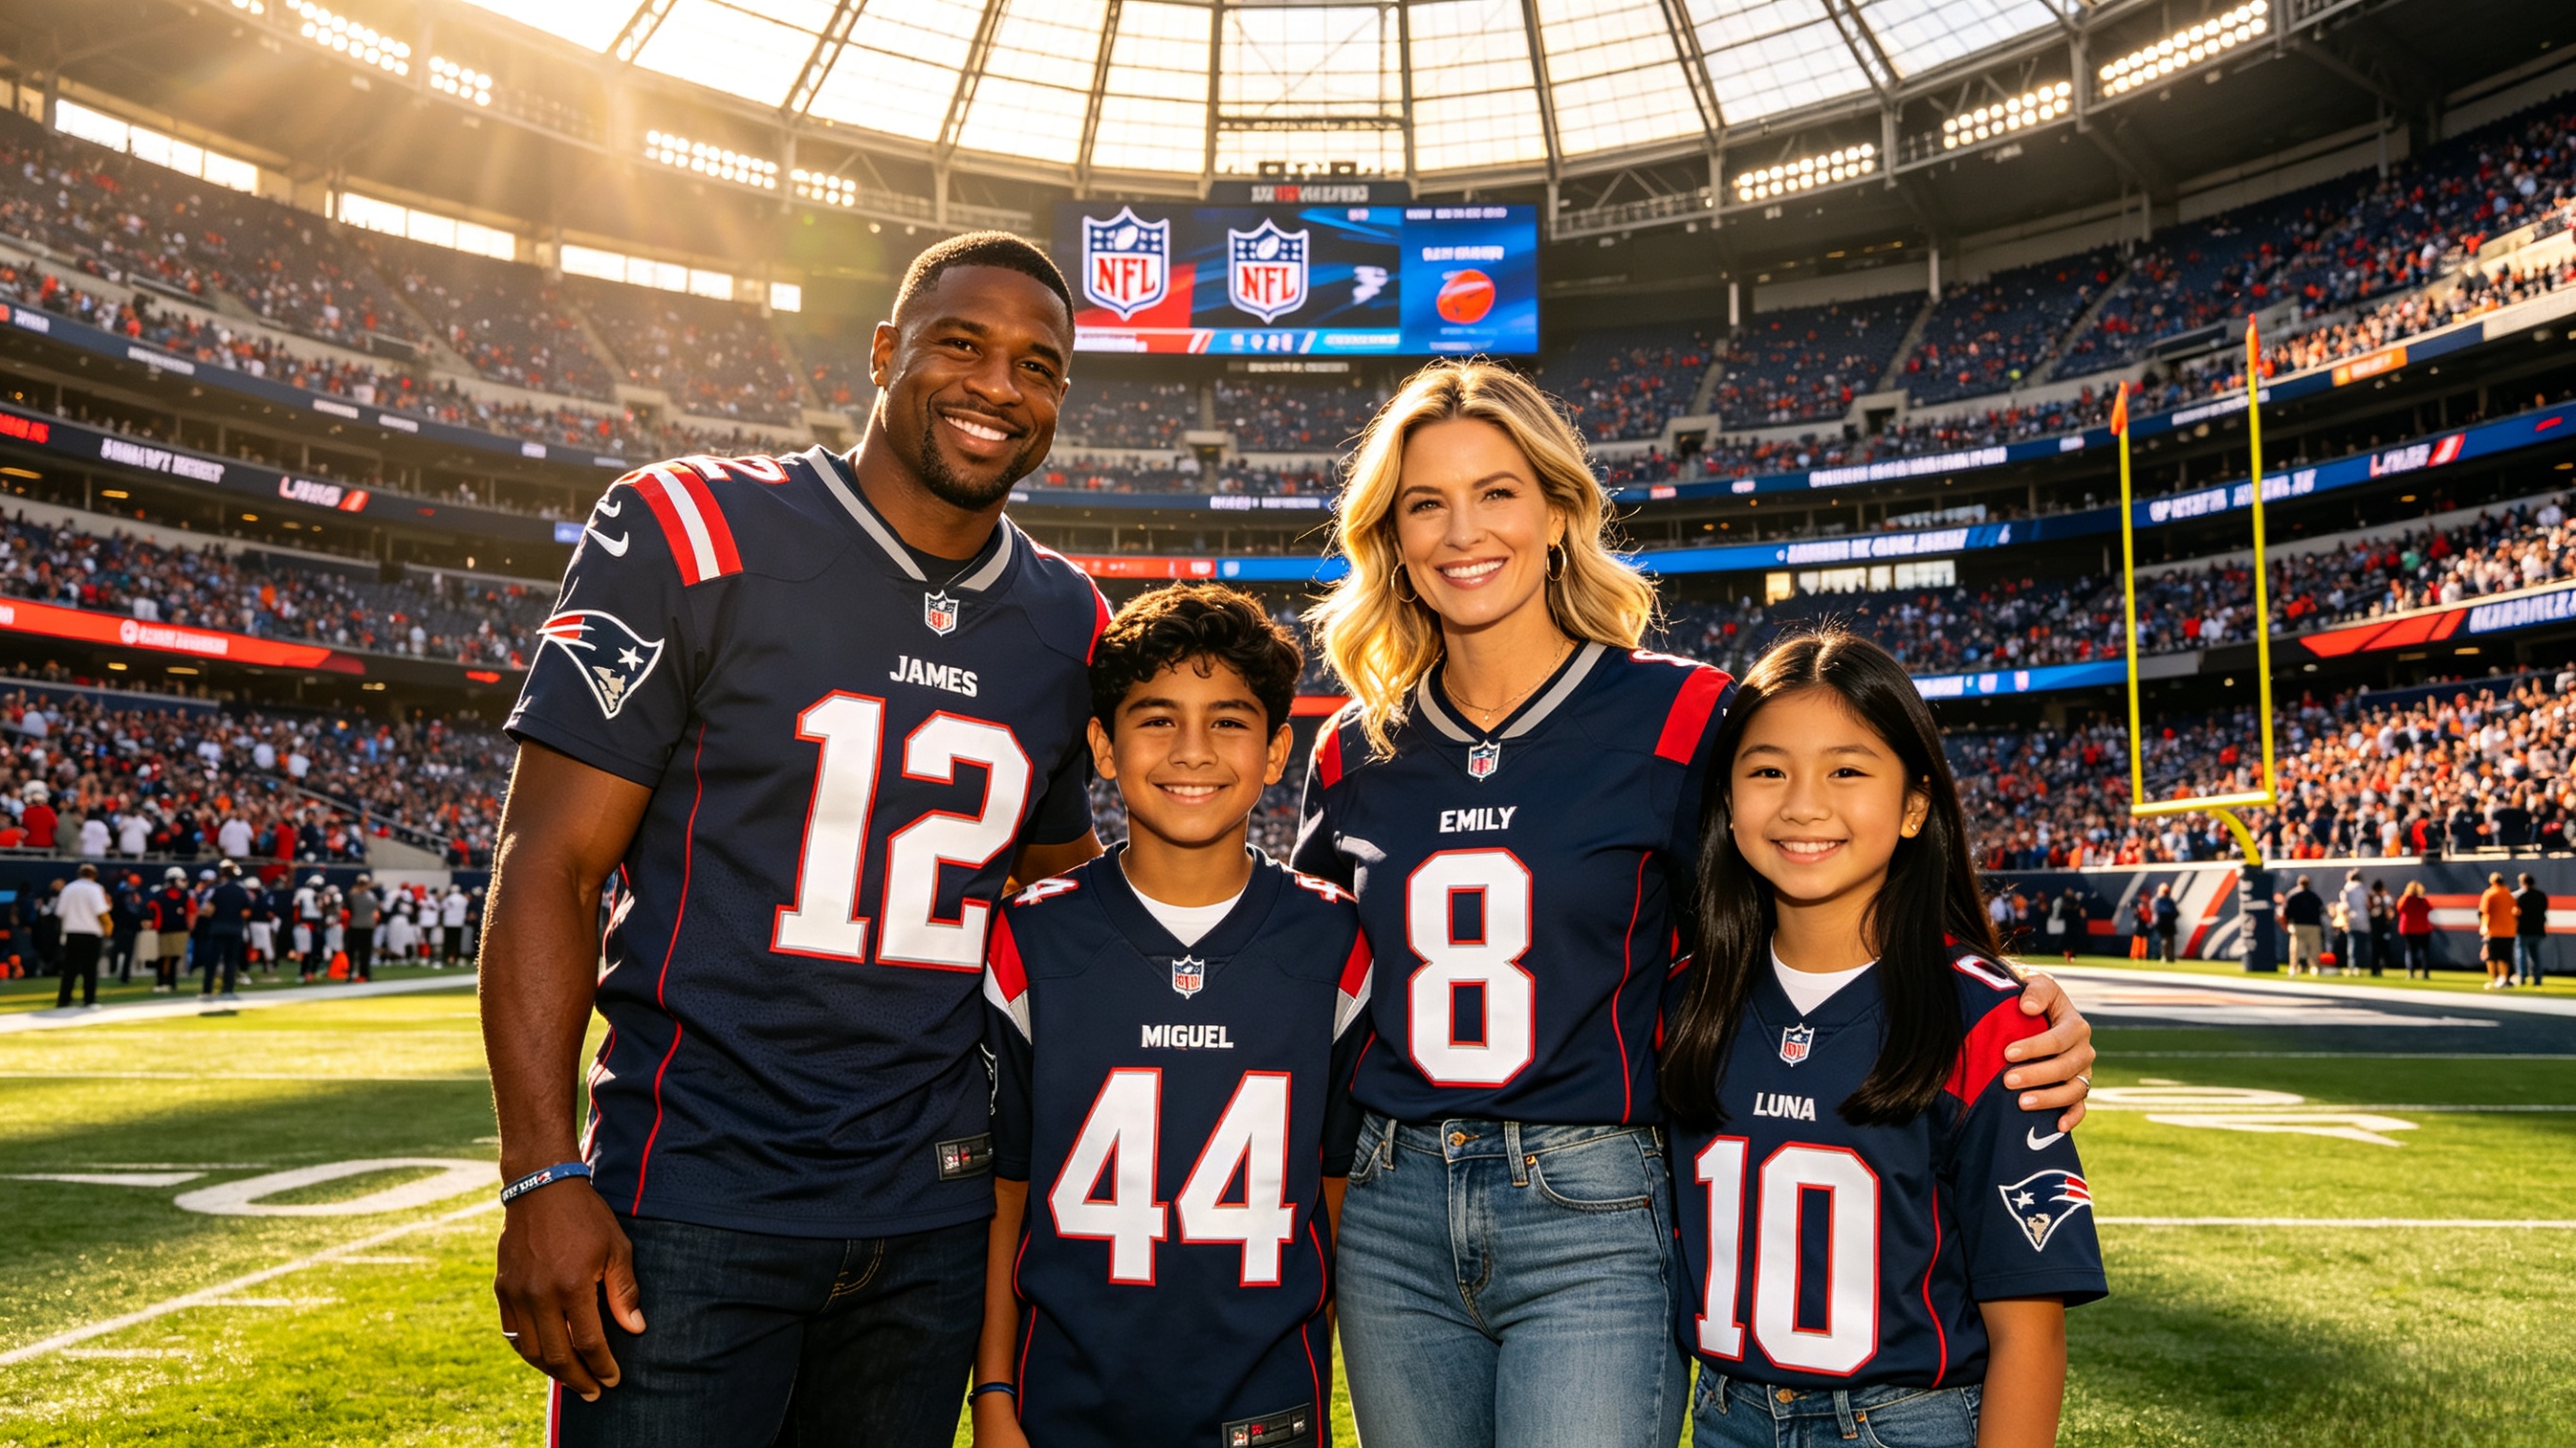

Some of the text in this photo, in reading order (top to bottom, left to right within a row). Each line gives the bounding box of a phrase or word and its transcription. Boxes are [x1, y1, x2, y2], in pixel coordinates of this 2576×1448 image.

[1096, 258, 1156, 302] NFL
[1240, 266, 1296, 305] NFL
[889, 655, 978, 697] JAMES
[770, 690, 1032, 972] 12
[1439, 806, 1517, 833] EMILY
[1405, 847, 1536, 1089] 8
[1141, 1024, 1234, 1048] MIGUEL
[1753, 1091, 1816, 1122] LUNA
[1047, 1067, 1296, 1287] 44
[1694, 1135, 1880, 1377] 10
